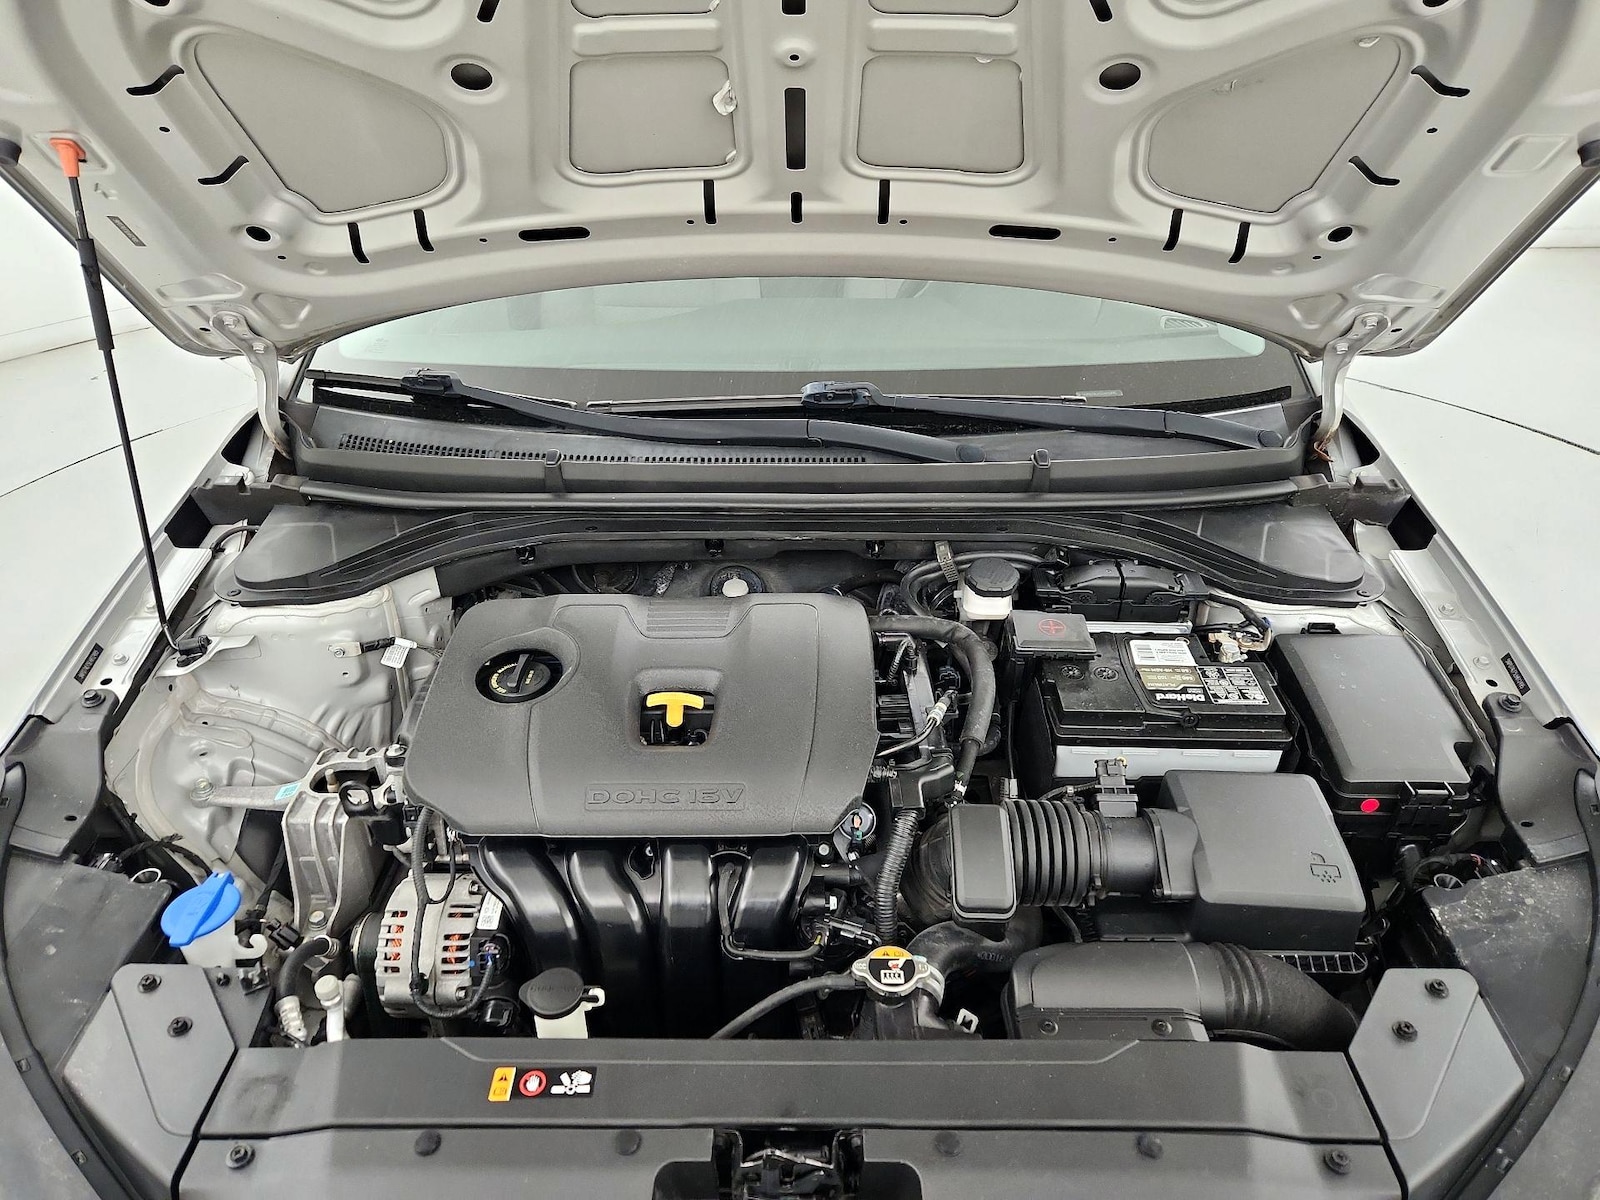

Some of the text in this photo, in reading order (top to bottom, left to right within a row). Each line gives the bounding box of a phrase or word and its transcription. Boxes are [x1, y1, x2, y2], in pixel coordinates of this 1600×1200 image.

[1155, 692, 1206, 702] DieHard
[587, 788, 744, 804] DOHC 16V
